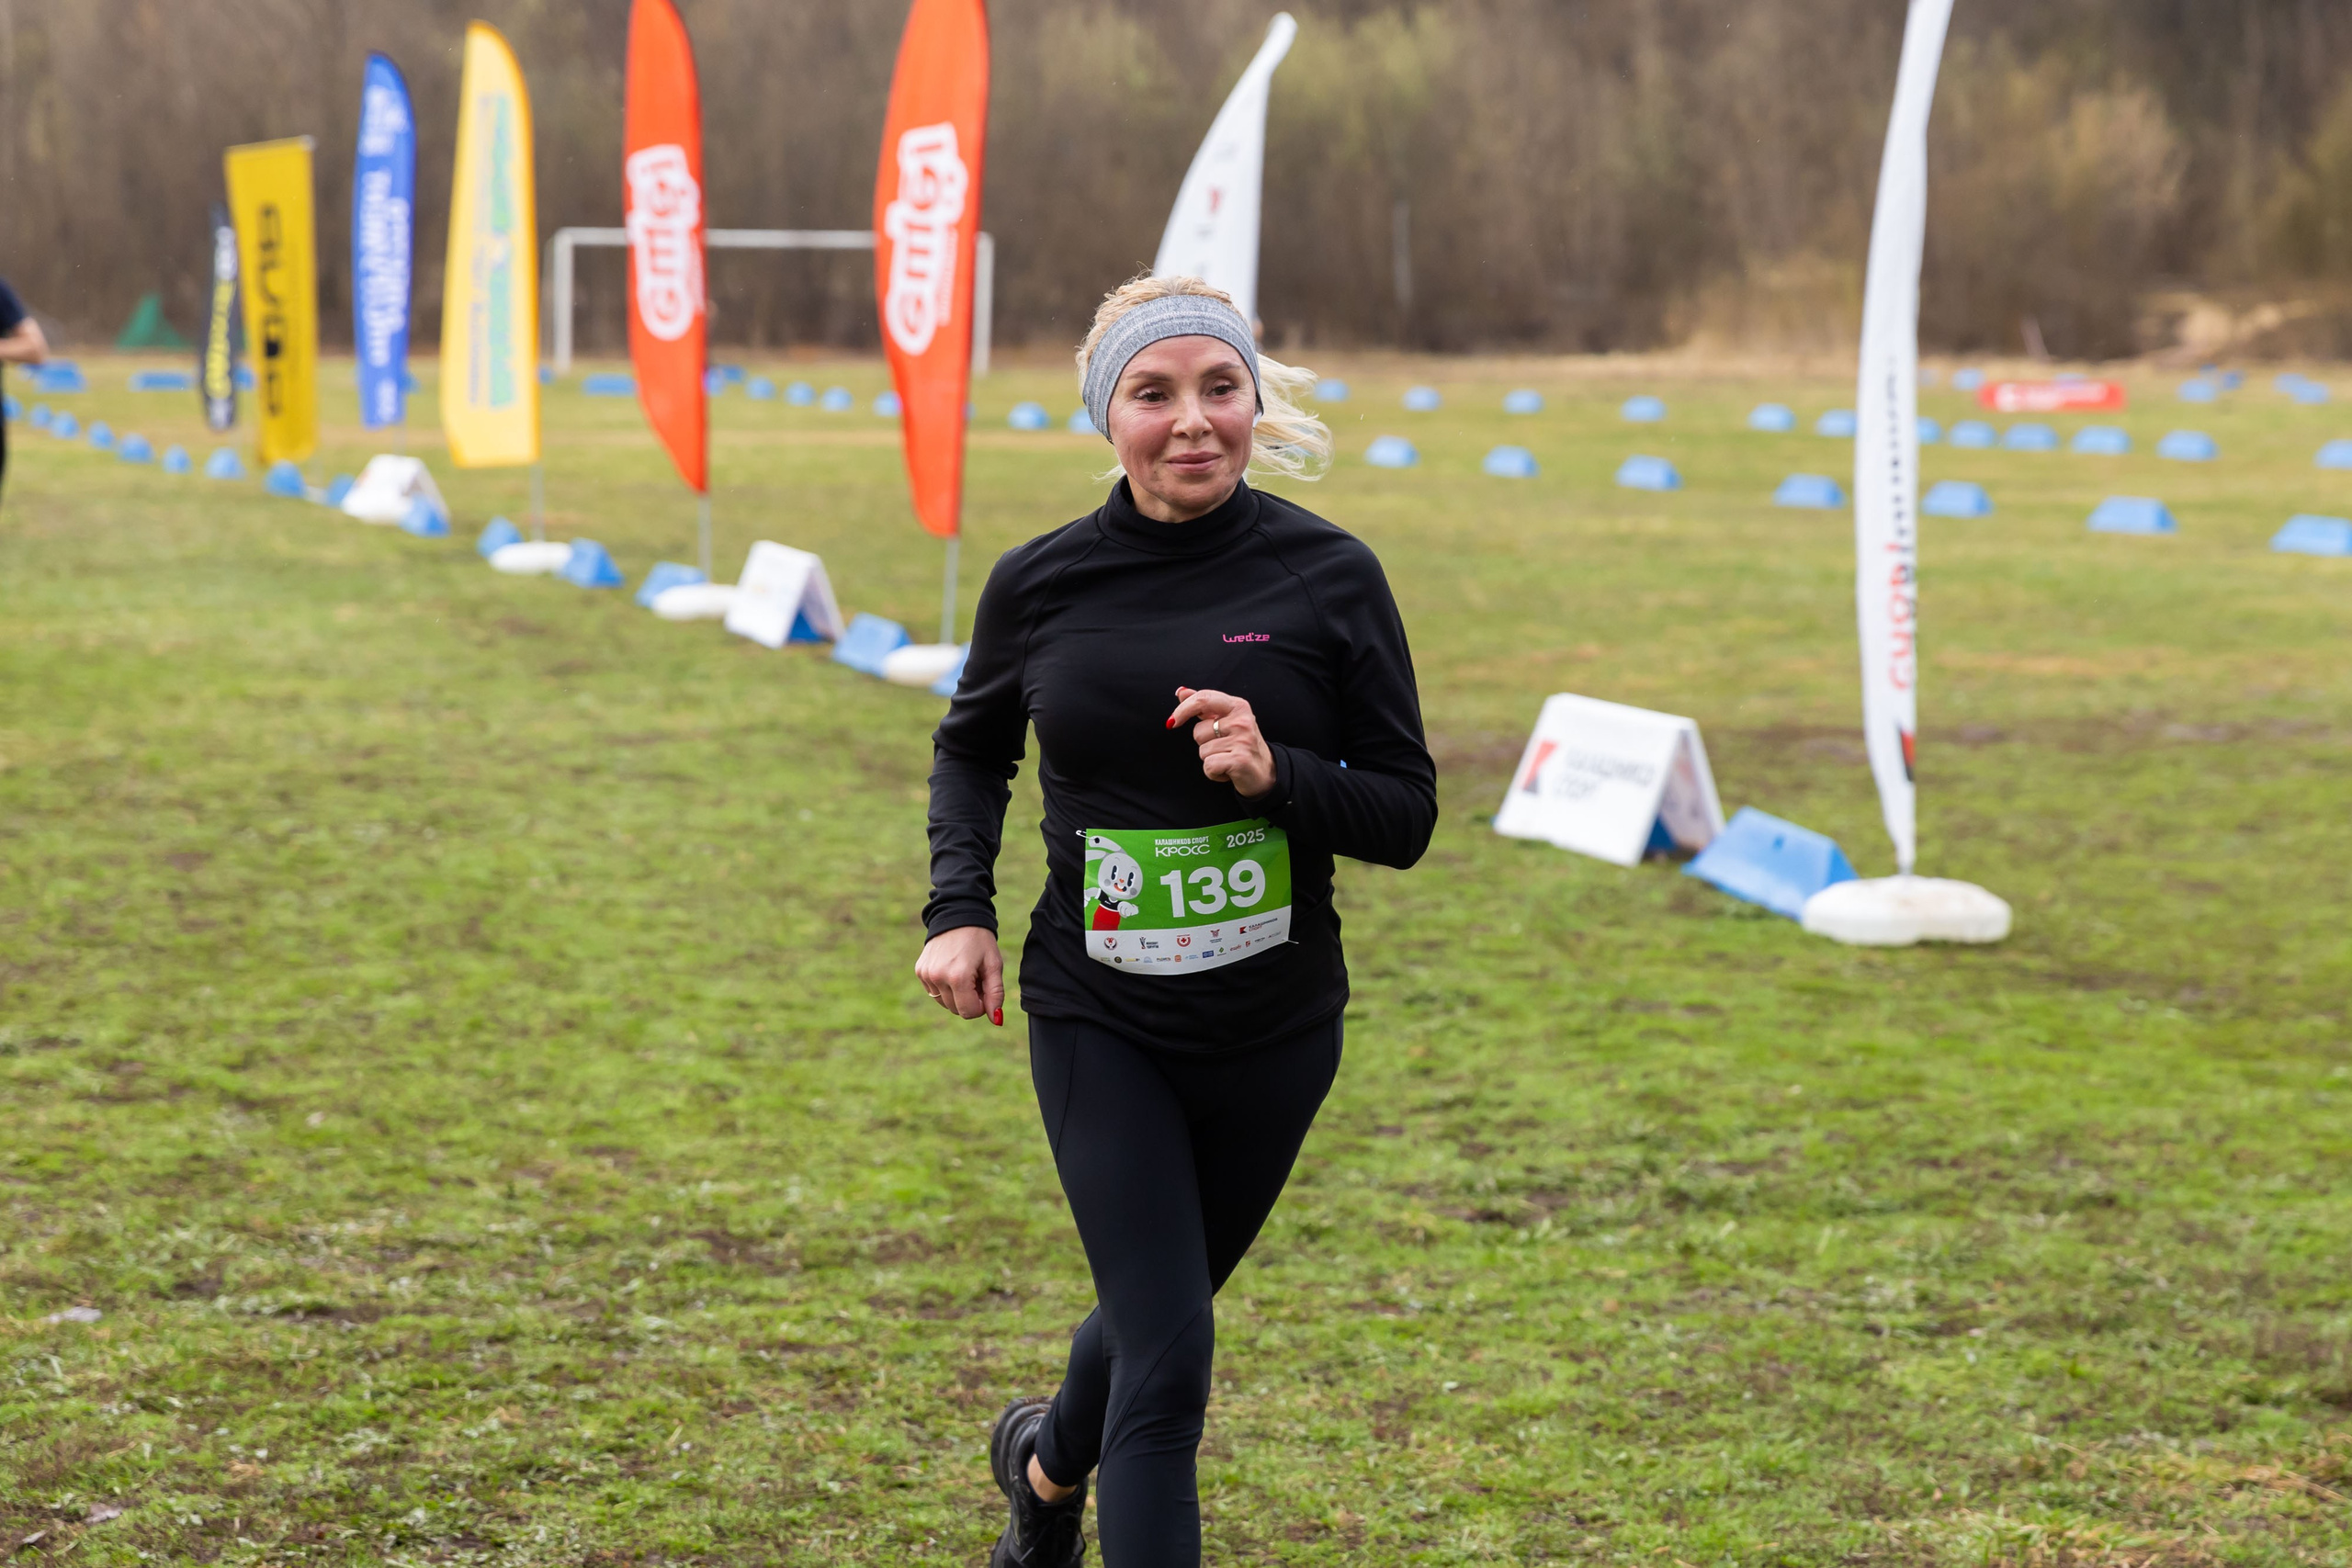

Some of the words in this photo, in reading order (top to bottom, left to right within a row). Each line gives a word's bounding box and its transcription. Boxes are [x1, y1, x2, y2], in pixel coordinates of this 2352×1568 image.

[1154, 838, 1191, 846] КАЛАШНИКОВ
[1192, 835, 1209, 844] СПОРТ
[1226, 828, 1265, 849] 2025
[1155, 844, 1211, 858] КРОСС
[1159, 859, 1266, 919] 139
